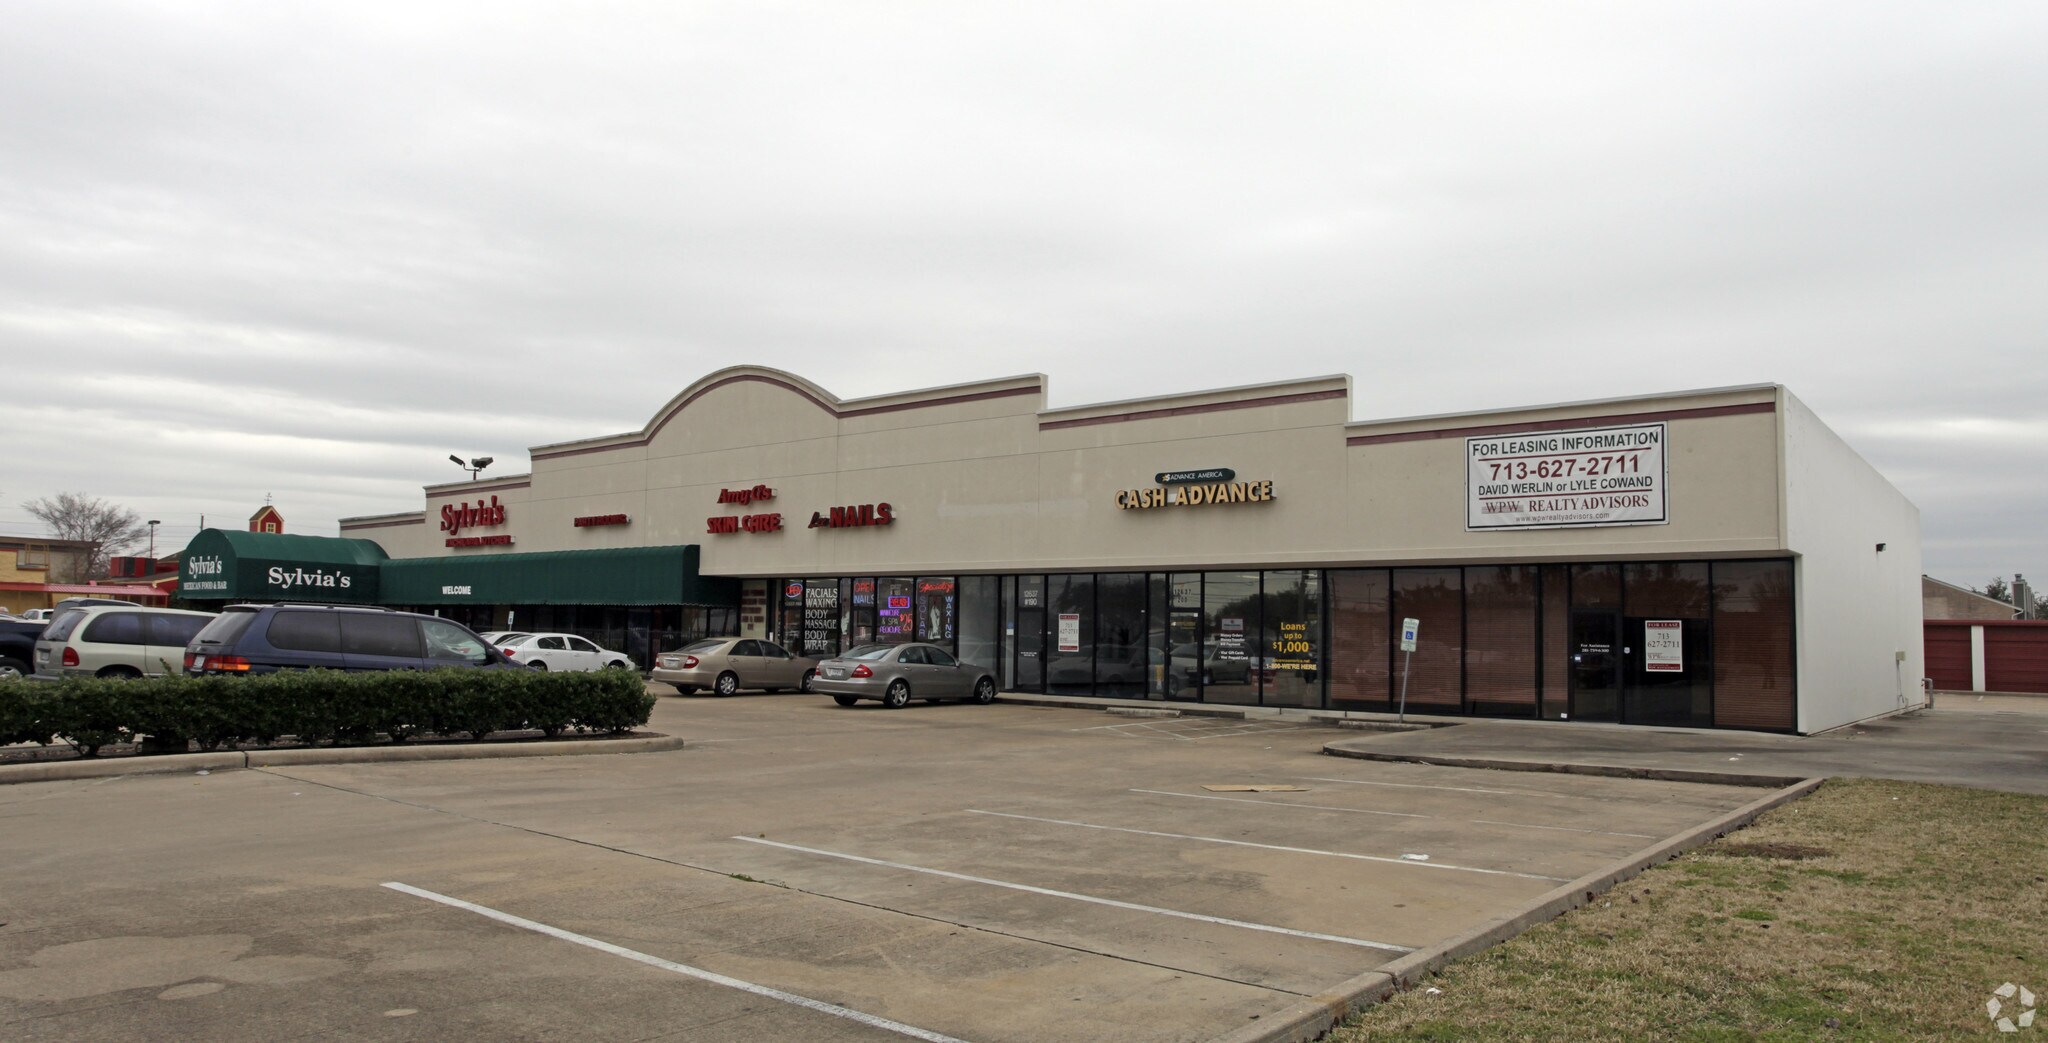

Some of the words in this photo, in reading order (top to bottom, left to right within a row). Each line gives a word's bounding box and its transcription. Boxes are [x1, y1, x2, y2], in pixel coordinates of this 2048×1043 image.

[1472, 443, 1498, 456] FOR
[1501, 439, 1558, 455] LEASING
[1562, 432, 1659, 450] INFORMATION
[1490, 454, 1639, 481] 713-627-2711
[1170, 472, 1195, 481] ADVANCE
[1198, 471, 1223, 479] AMERICA
[1478, 485, 1509, 496] DAVID
[1512, 482, 1551, 493] WERLIN
[1556, 483, 1567, 492] or
[1570, 479, 1597, 491] LYLE
[1600, 476, 1653, 488] COWAND
[717, 488, 750, 505] Amy
[1115, 487, 1167, 509] CASH
[1175, 481, 1272, 506] ADVANCE
[1485, 502, 1520, 513] WPW
[1529, 499, 1580, 512] REALTY
[1582, 495, 1649, 510] ADVISORS
[440, 495, 506, 535] Sylvia's
[830, 502, 893, 528] NAILS
[1515, 513, 1610, 522] www.wpwrealtyadvisors.com
[706, 516, 739, 534] SKIN
[741, 513, 782, 533] CARE
[188, 555, 222, 579] Sylvia's
[217, 580, 227, 590] BAR
[268, 566, 351, 589] Sylvia's
[442, 585, 471, 595] WELCOME
[805, 588, 838, 599] FACIALS
[805, 598, 837, 608] WAXING
[805, 609, 829, 619] BODY
[944, 595, 954, 639] WAXING
[805, 620, 837, 629] MASSAGE
[1280, 622, 1306, 631] Loans
[804, 630, 828, 640] BODY
[804, 640, 828, 650] WRAP
[1272, 641, 1309, 654] $1,000
